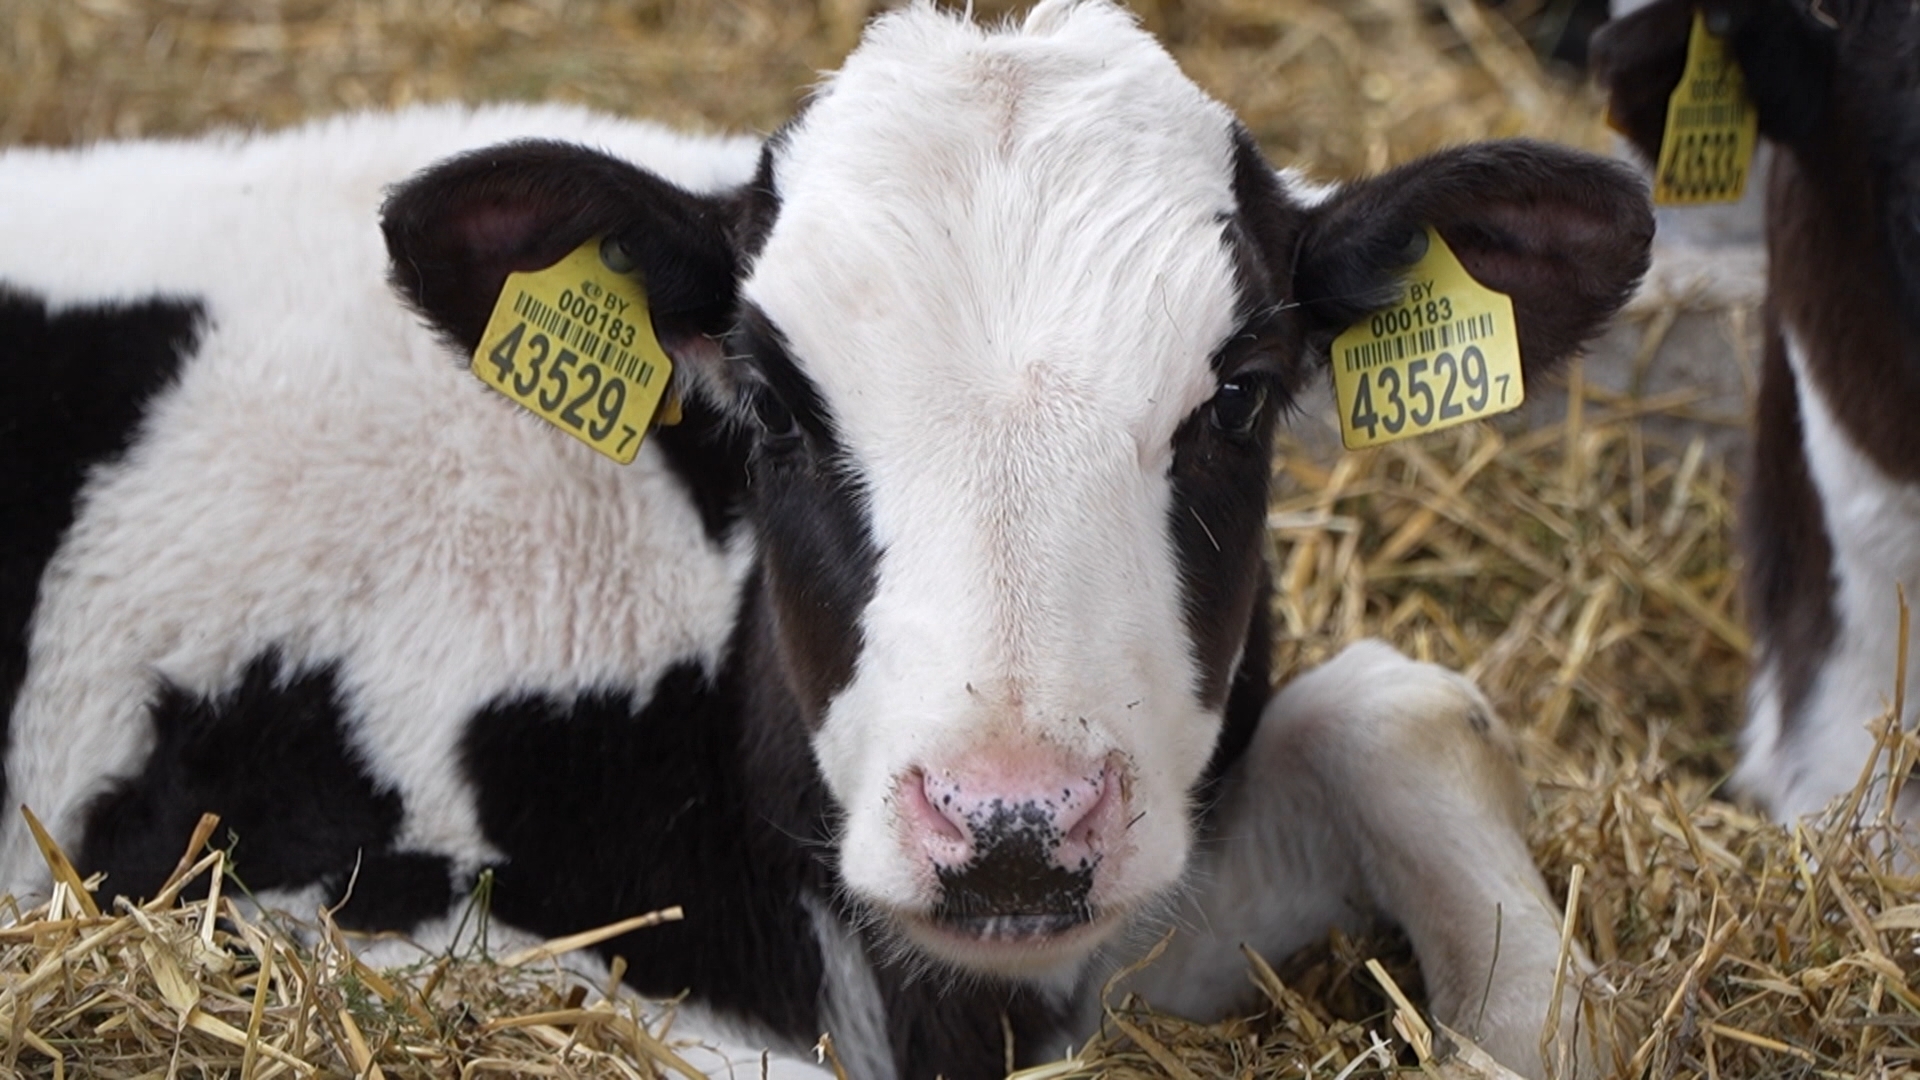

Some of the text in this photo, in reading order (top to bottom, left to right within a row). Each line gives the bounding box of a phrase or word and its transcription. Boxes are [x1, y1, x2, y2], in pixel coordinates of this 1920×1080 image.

[603, 291, 630, 316] BY
[1410, 280, 1435, 302] BY
[558, 289, 636, 348] 000183
[1371, 297, 1453, 339] 000183
[488, 321, 637, 454] 43529 7
[1351, 344, 1511, 440] 43529 7
